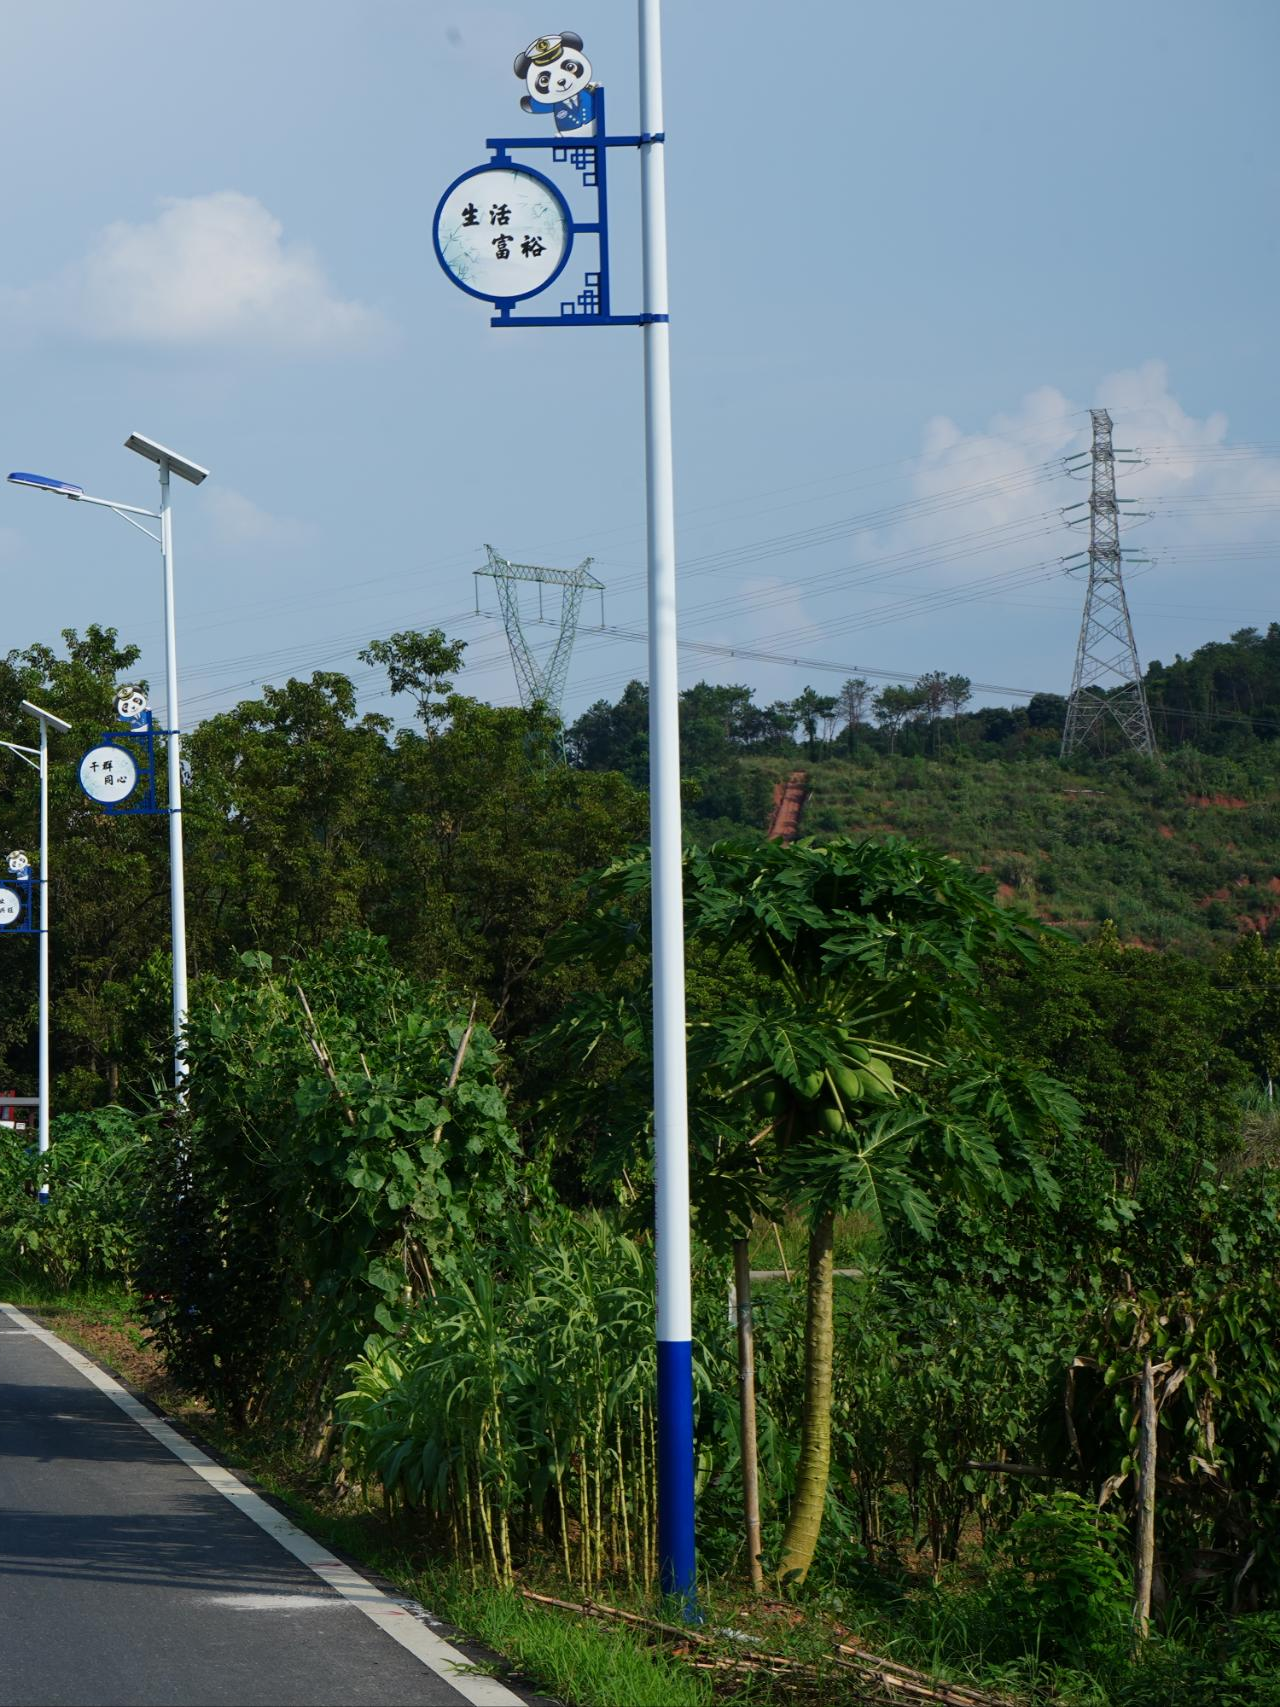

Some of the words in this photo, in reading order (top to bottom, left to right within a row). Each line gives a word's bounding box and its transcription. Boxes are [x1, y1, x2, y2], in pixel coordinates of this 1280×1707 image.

[461, 203, 512, 227] 生活
[491, 233, 547, 260] 富裕
[90, 760, 113, 773] 干群
[104, 774, 128, 786] 同心
